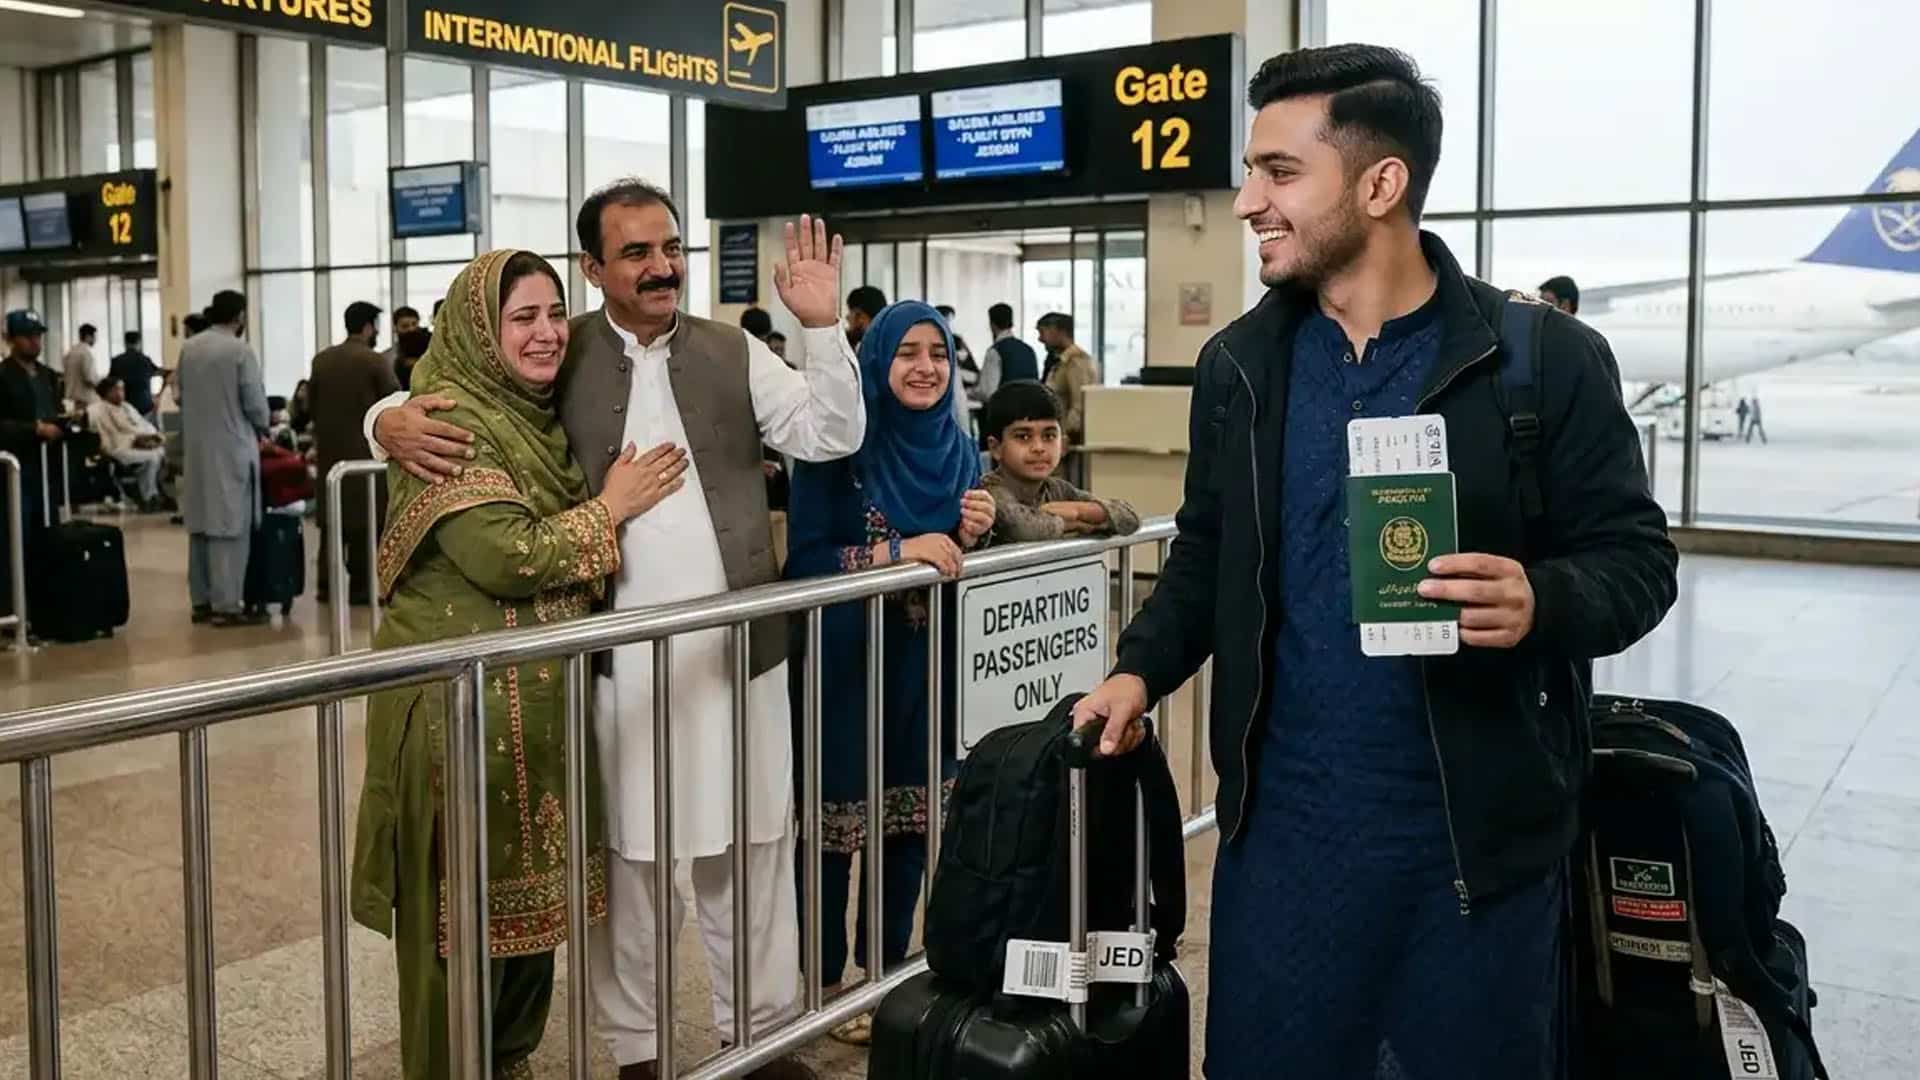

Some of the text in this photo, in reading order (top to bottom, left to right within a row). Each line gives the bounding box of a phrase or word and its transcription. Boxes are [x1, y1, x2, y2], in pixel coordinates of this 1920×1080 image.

[200, 0, 373, 28] URES
[424, 10, 719, 85] INTERNATIONAL FLIGHTS
[1115, 63, 1208, 106] Gate
[1131, 117, 1191, 171] 12
[109, 212, 132, 244] 12
[983, 586, 1090, 636] DEPARTING
[973, 623, 1098, 682] PASSENGERS
[1014, 672, 1063, 711] ONLY
[1099, 946, 1144, 968] JED
[1738, 1039, 1760, 1074] JED
